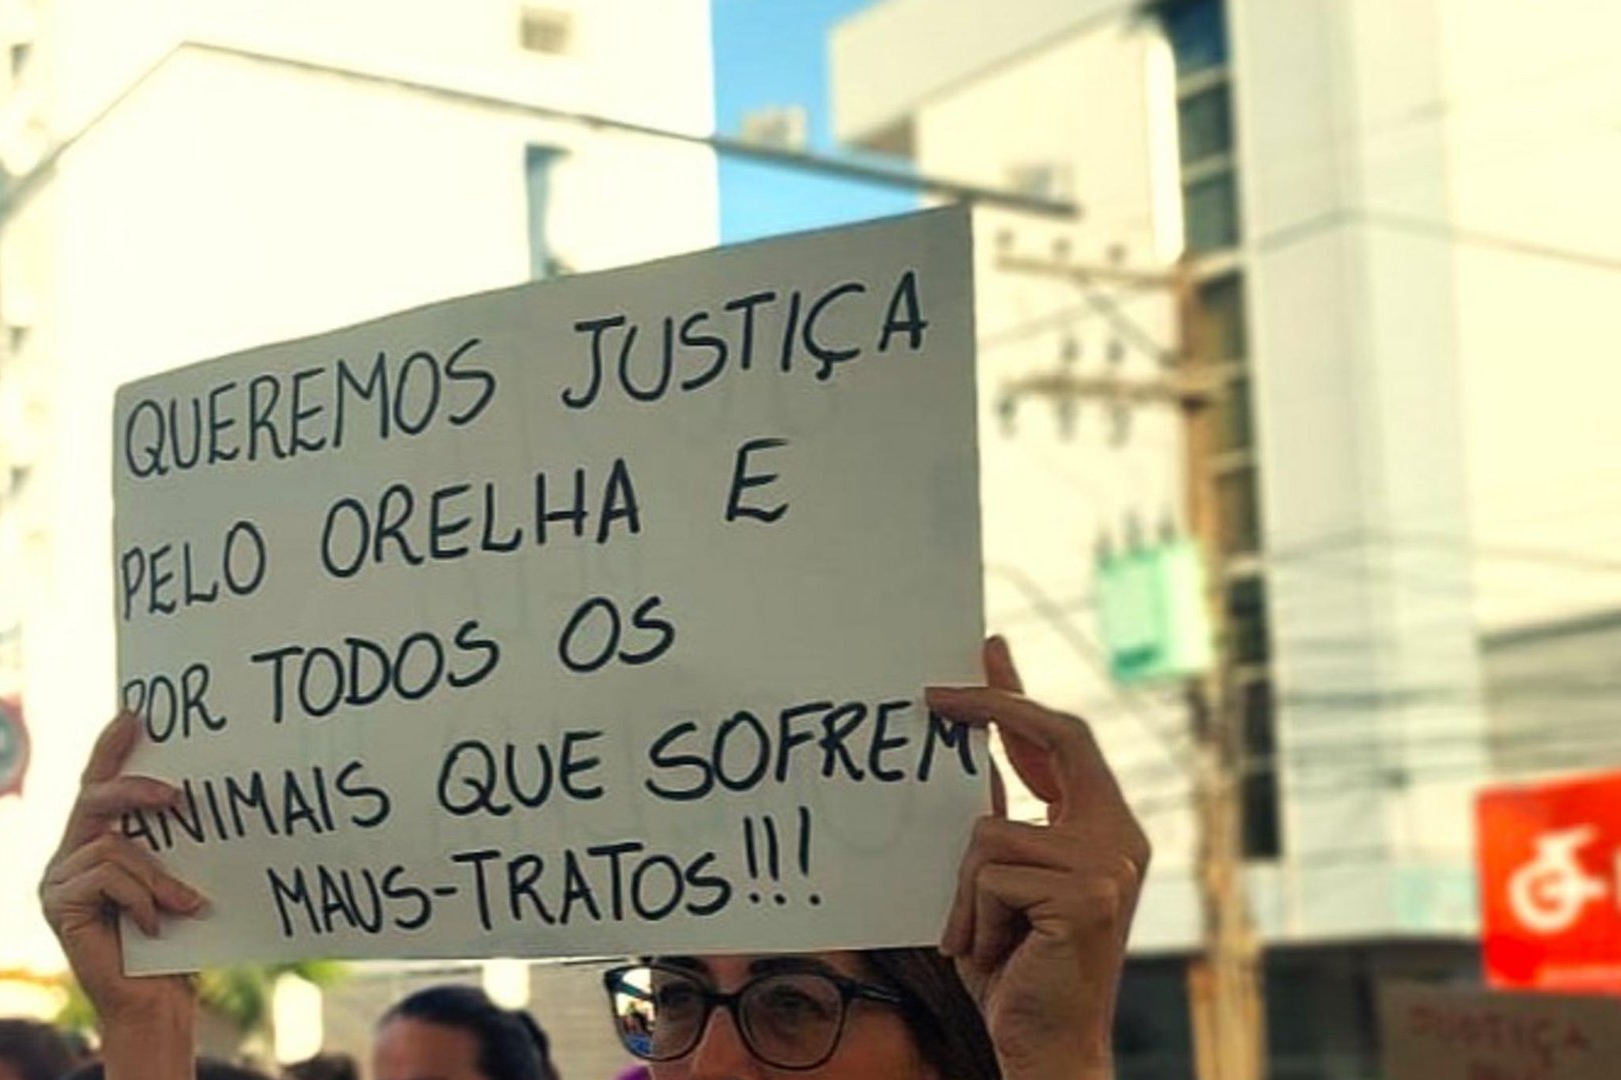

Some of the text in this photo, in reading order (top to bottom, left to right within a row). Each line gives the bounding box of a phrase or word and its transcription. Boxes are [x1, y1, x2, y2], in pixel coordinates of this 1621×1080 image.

[125, 269, 930, 479] QUEREMOS JUSTIÇA
[121, 437, 790, 620] PELO ORELHA E
[122, 595, 676, 744] POR TODOS OS
[121, 700, 979, 853] ANIMAIS QUE SOFREM
[266, 805, 822, 939] MAUS-TRATOS!!!
